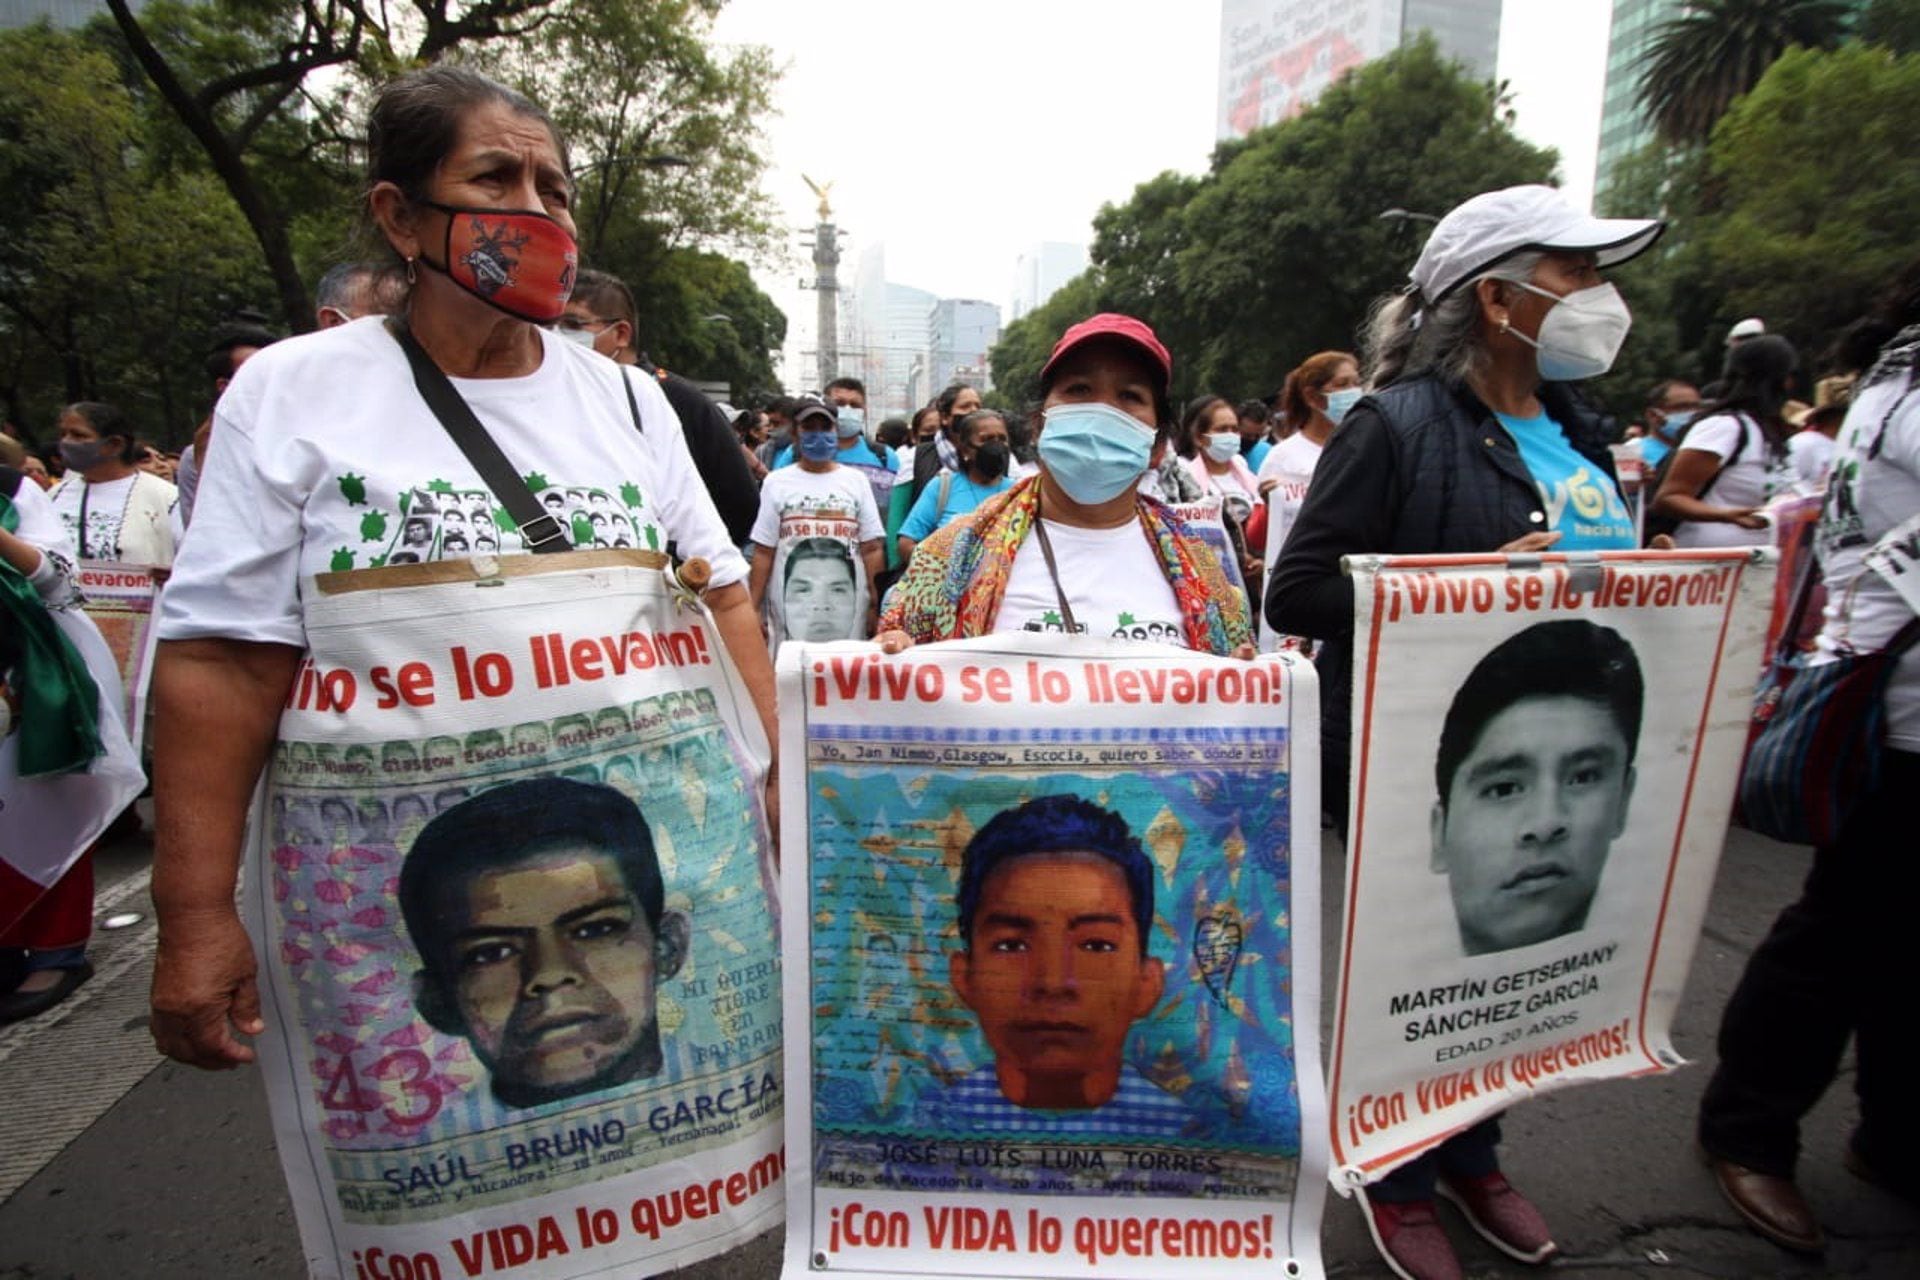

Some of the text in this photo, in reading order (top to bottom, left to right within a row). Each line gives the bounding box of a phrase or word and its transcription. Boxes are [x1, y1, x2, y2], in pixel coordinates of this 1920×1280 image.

[1388, 569, 1494, 624] ¡Vivo
[1505, 573, 1543, 612] se
[370, 660, 436, 710] se
[450, 645, 515, 701] lo
[814, 657, 1281, 707] ¡Vivo se lo llevaron!
[856, 745, 881, 759] Jan
[1024, 747, 1089, 764] Escocia,
[1099, 747, 1149, 764] quiero
[1155, 747, 1197, 762] saber
[1389, 941, 1619, 1016] MARTÍN GETSEMANY
[1403, 972, 1599, 1042] SÁNCHEZ GARCÍA
[1435, 1036, 1494, 1063] EDAD
[1526, 1010, 1580, 1037] AÑOS
[1347, 1090, 1407, 1149] ¡Con
[1510, 1017, 1632, 1091] queremos!
[382, 1071, 779, 1198] SAÚL BRUNO GARCÍA
[876, 1140, 940, 1165] JOSÉ
[1041, 1147, 1106, 1171] LUNA
[1122, 1149, 1222, 1175] TORRES
[451, 1215, 569, 1277] VIDA
[575, 1204, 620, 1243] lo
[829, 1202, 1273, 1266] ¡Con VIDA lo queremos!
